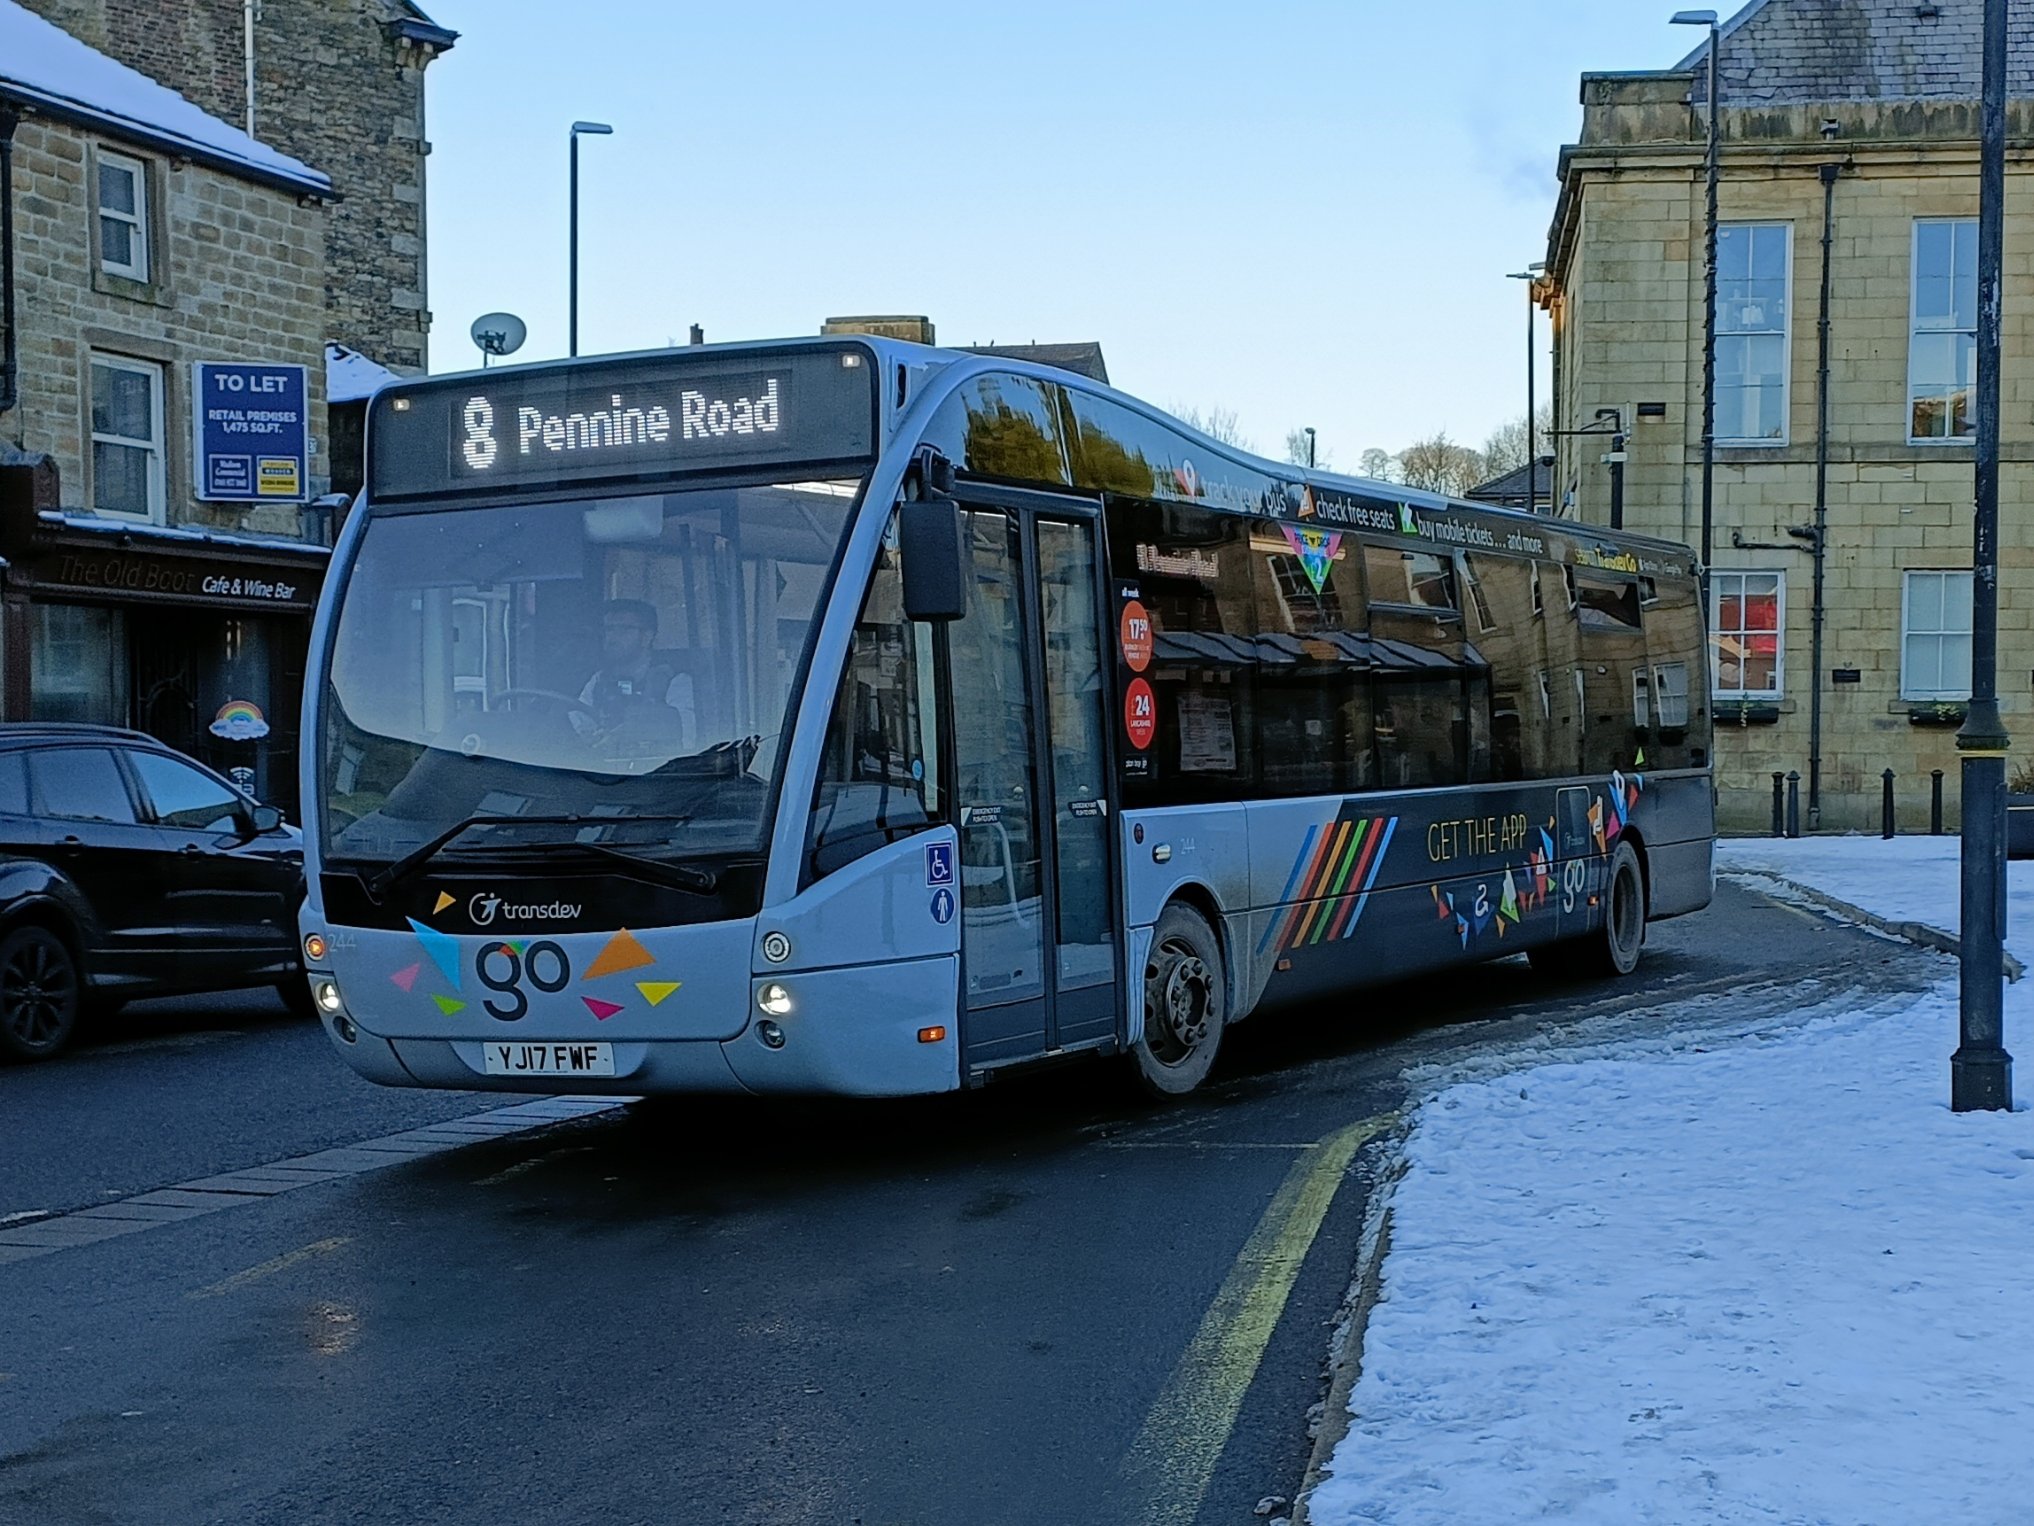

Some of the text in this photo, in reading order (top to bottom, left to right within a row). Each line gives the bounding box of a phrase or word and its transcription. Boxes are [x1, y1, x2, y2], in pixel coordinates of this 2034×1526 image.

[214, 374, 288, 392] TO LET
[208, 409, 297, 422] RETAIL PREMISES
[462, 378, 779, 469] 8 Pennine Road
[1264, 484, 1286, 512] bus
[1316, 492, 1395, 530] check free seats
[1416, 511, 1435, 542] buy
[1436, 518, 1465, 543] mobile
[1507, 529, 1521, 551] and
[1523, 533, 1544, 553] more
[61, 555, 99, 584] The
[104, 560, 142, 586] Old
[230, 578, 242, 595] &
[244, 579, 274, 598] Wine
[274, 582, 297, 599] Bar
[1427, 814, 1527, 862] GET THE APP
[1563, 858, 1586, 914] go
[502, 900, 581, 919] transdev
[476, 940, 571, 1022] go
[497, 1045, 598, 1070] YJ17 FWF
